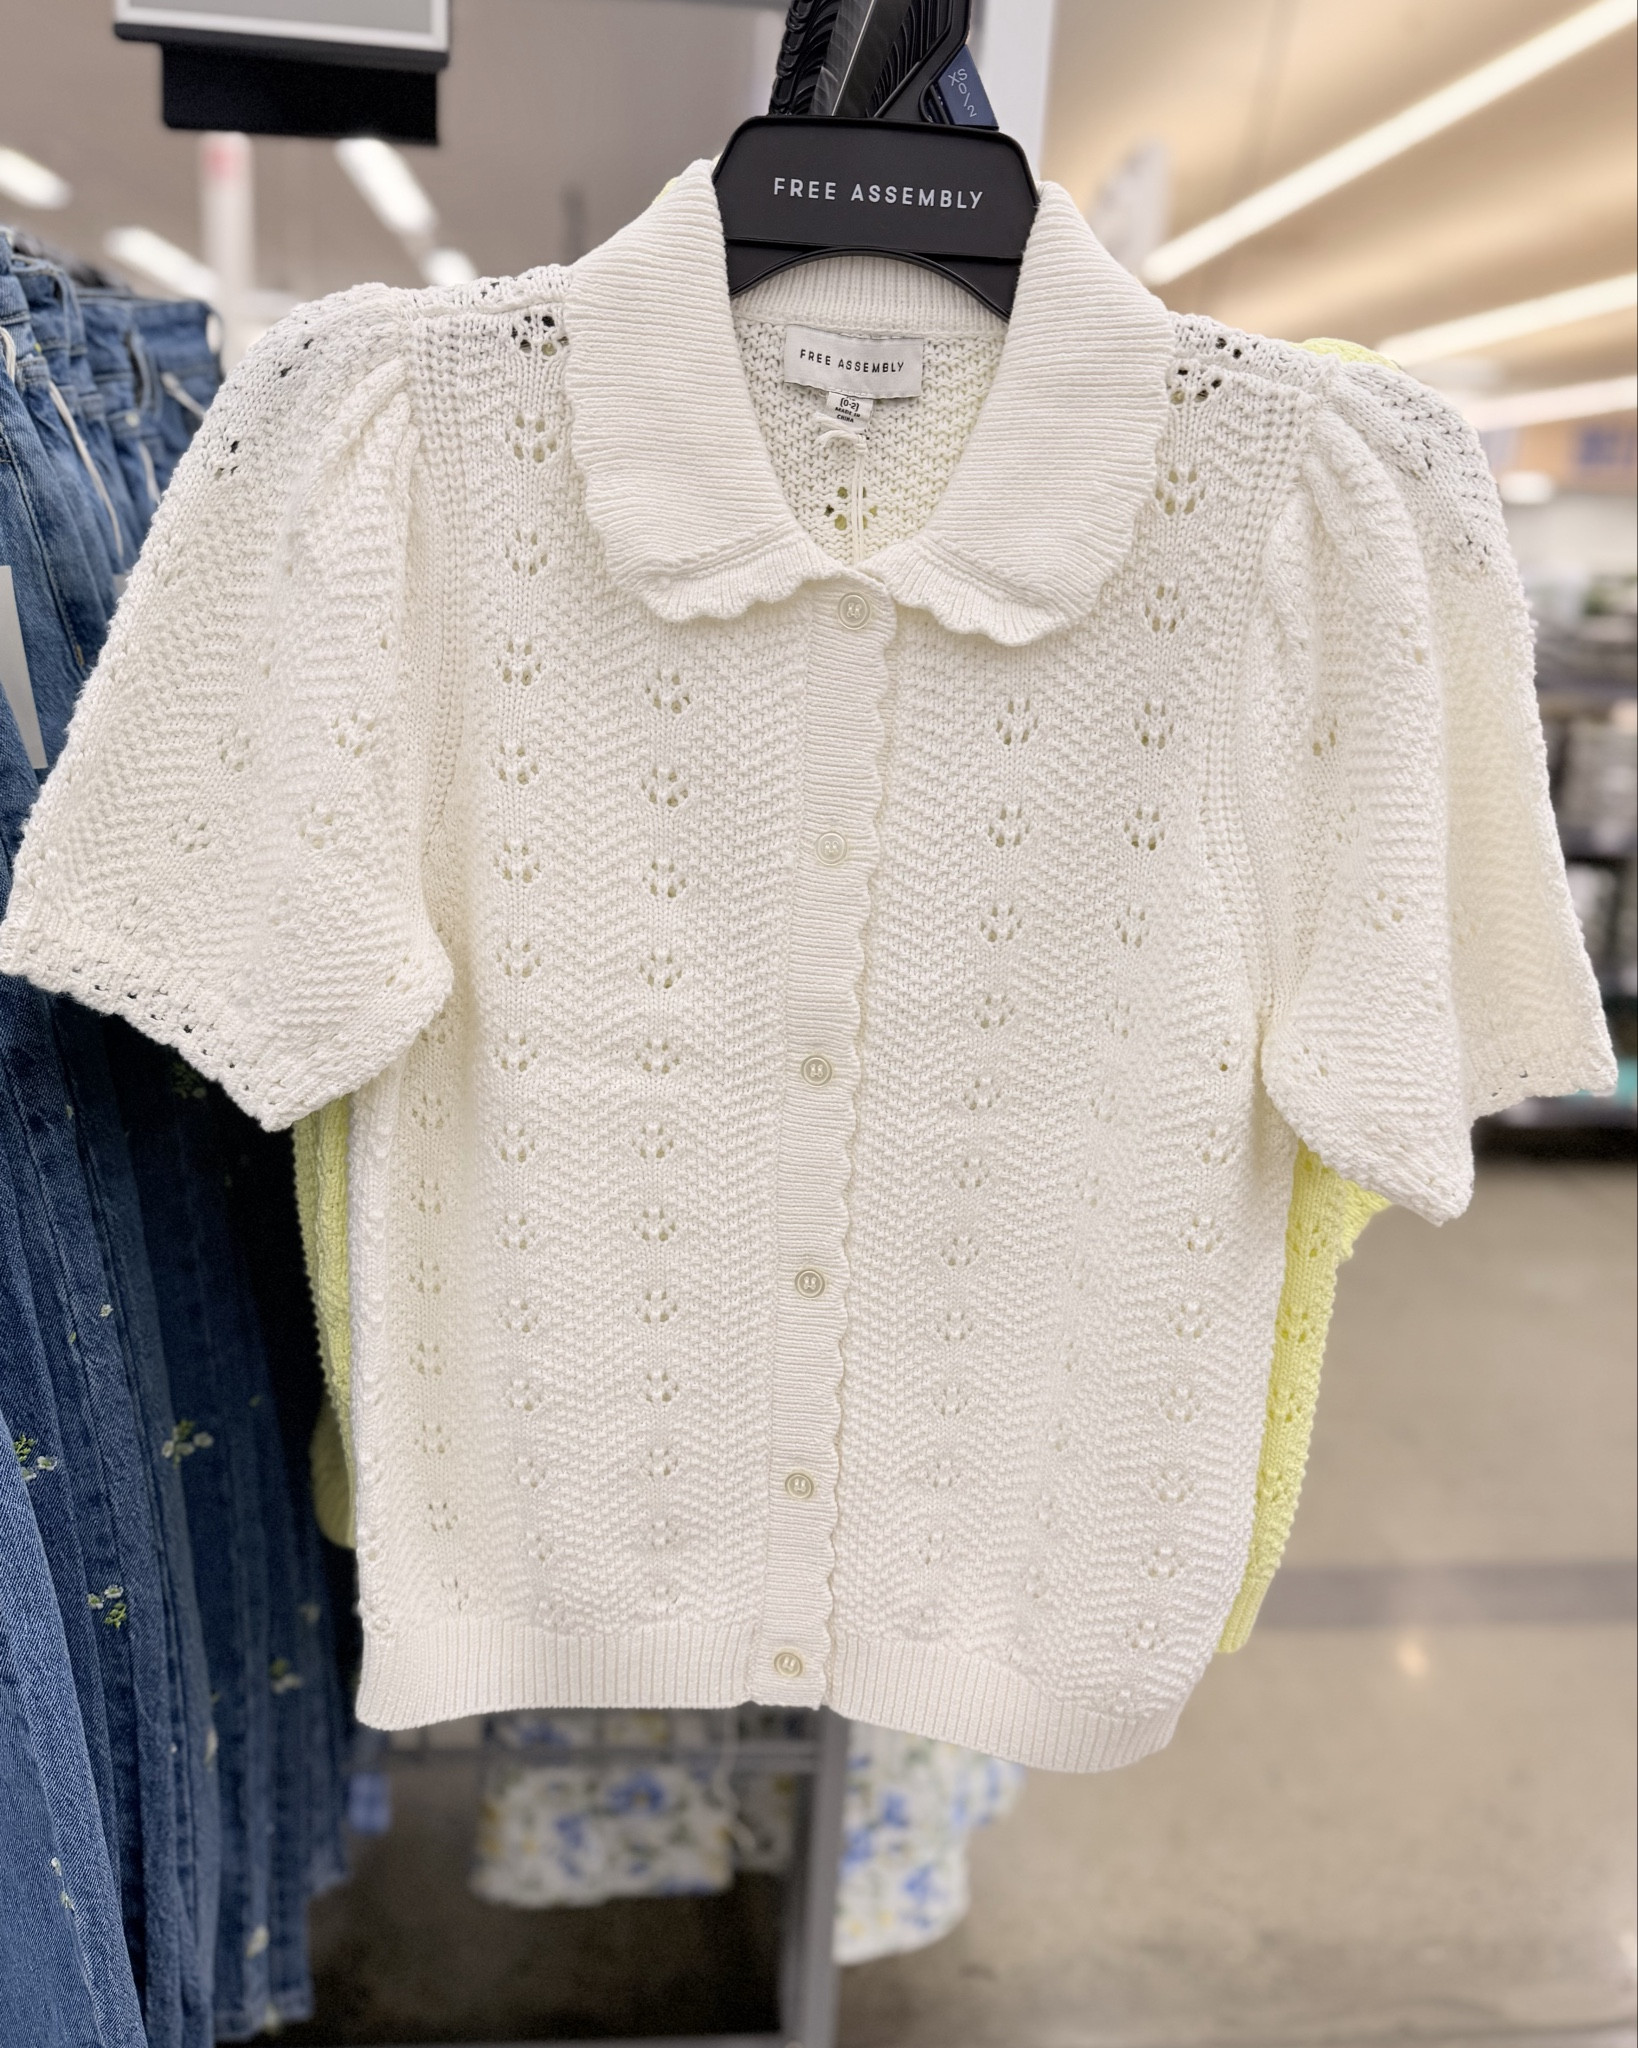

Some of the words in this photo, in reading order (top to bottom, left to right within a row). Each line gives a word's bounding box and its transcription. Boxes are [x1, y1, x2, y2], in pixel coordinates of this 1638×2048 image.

[948, 68, 968, 87] XS
[958, 82, 977, 118] 0/2
[773, 177, 836, 201] FREE
[850, 183, 984, 210] ASSEMBLY
[799, 348, 832, 366] FREE
[838, 358, 904, 373] ASSEMBLY
[835, 406, 852, 416] MADE
[836, 414, 854, 423] CHINA
